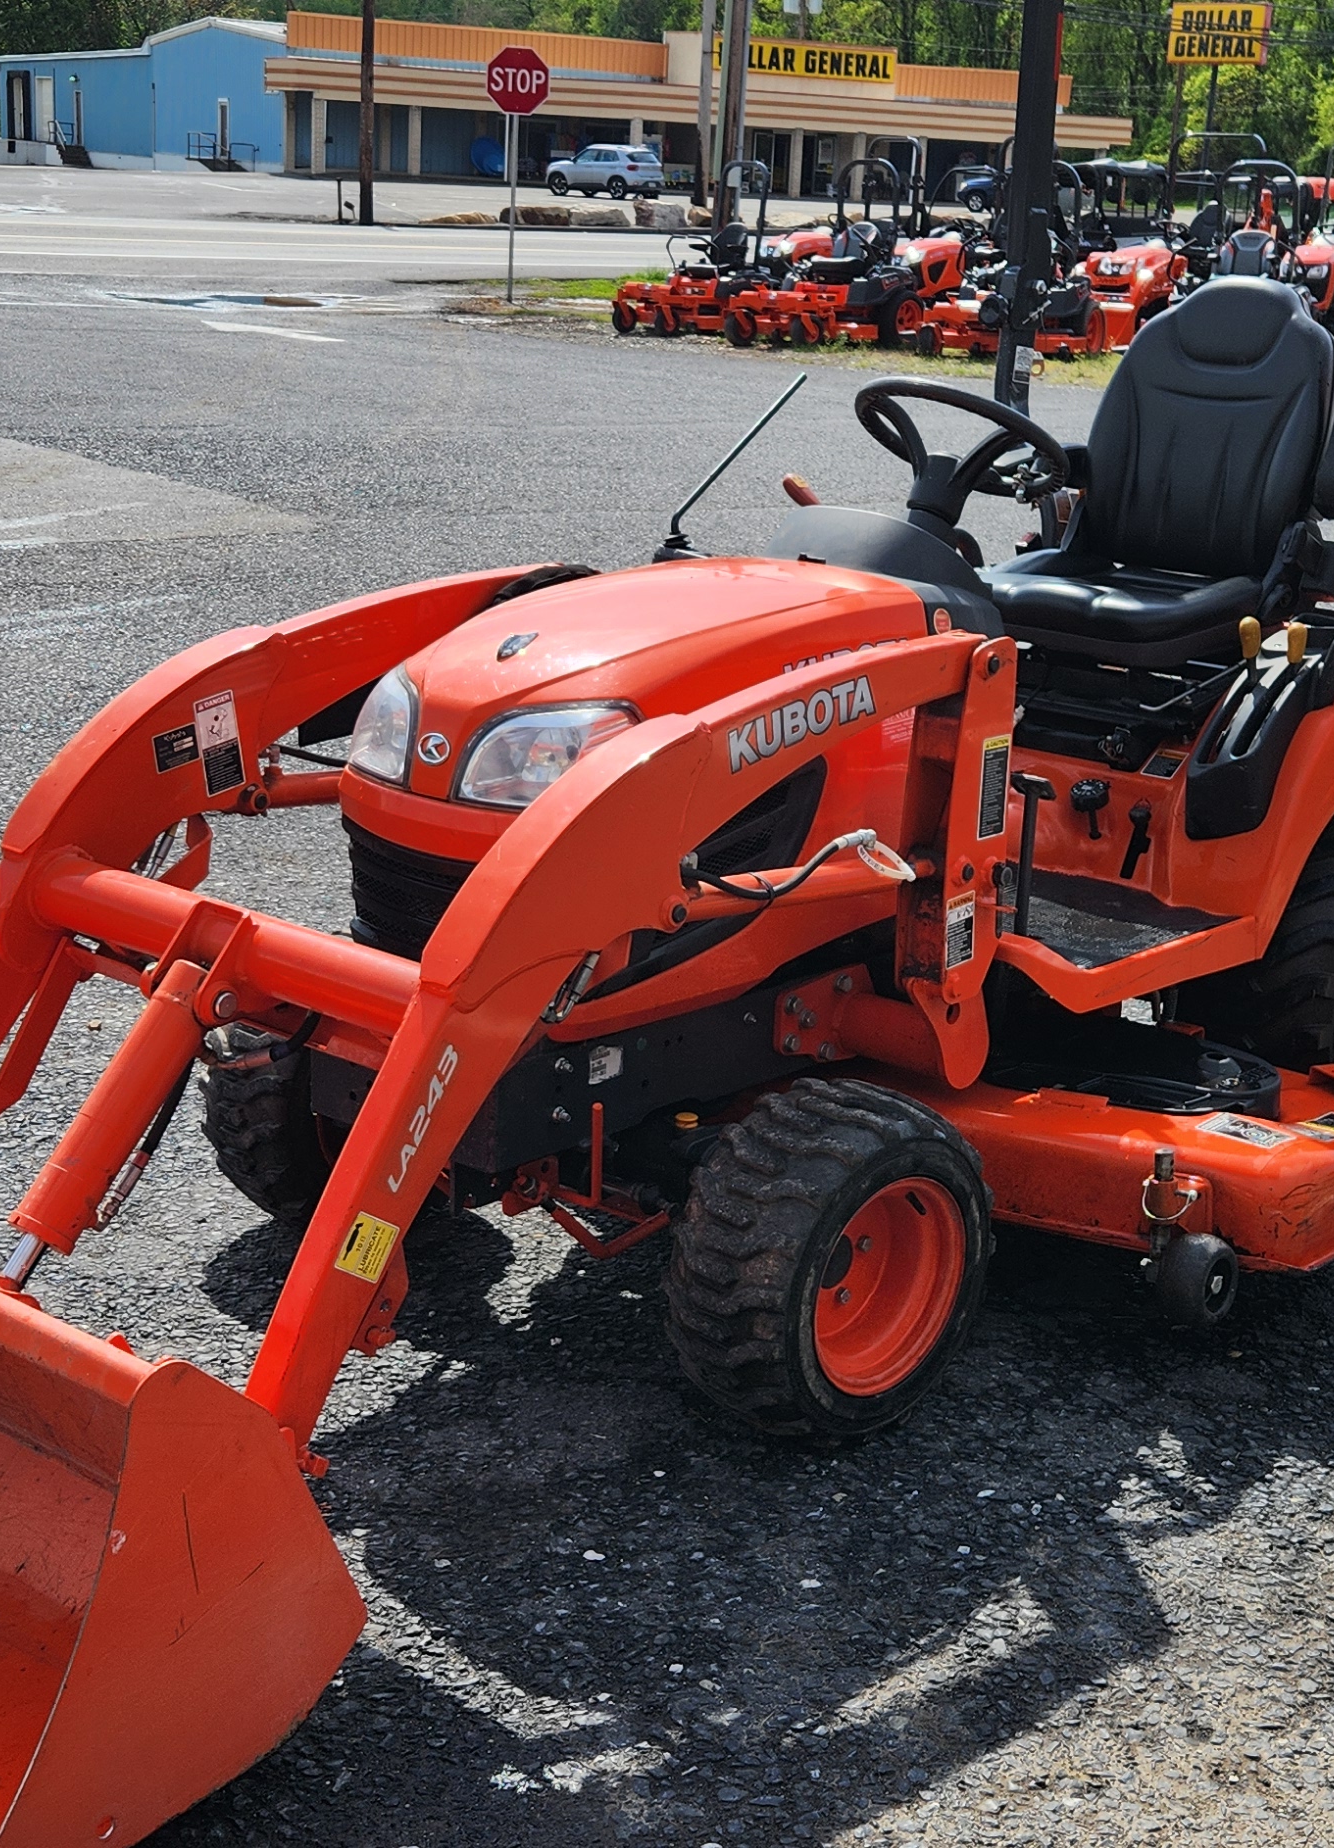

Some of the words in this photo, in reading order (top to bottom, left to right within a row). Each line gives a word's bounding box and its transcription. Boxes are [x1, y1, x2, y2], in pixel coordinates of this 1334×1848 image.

[1182, 10, 1252, 31] DOLLAR
[1174, 35, 1256, 57] GENERAL
[805, 50, 890, 79] GENERAL
[490, 66, 546, 94] STOP
[204, 695, 230, 708] DANGER
[728, 675, 876, 775] KUBOTA
[387, 1044, 458, 1193] LA243
[358, 1225, 382, 1271] LUBRICATE
